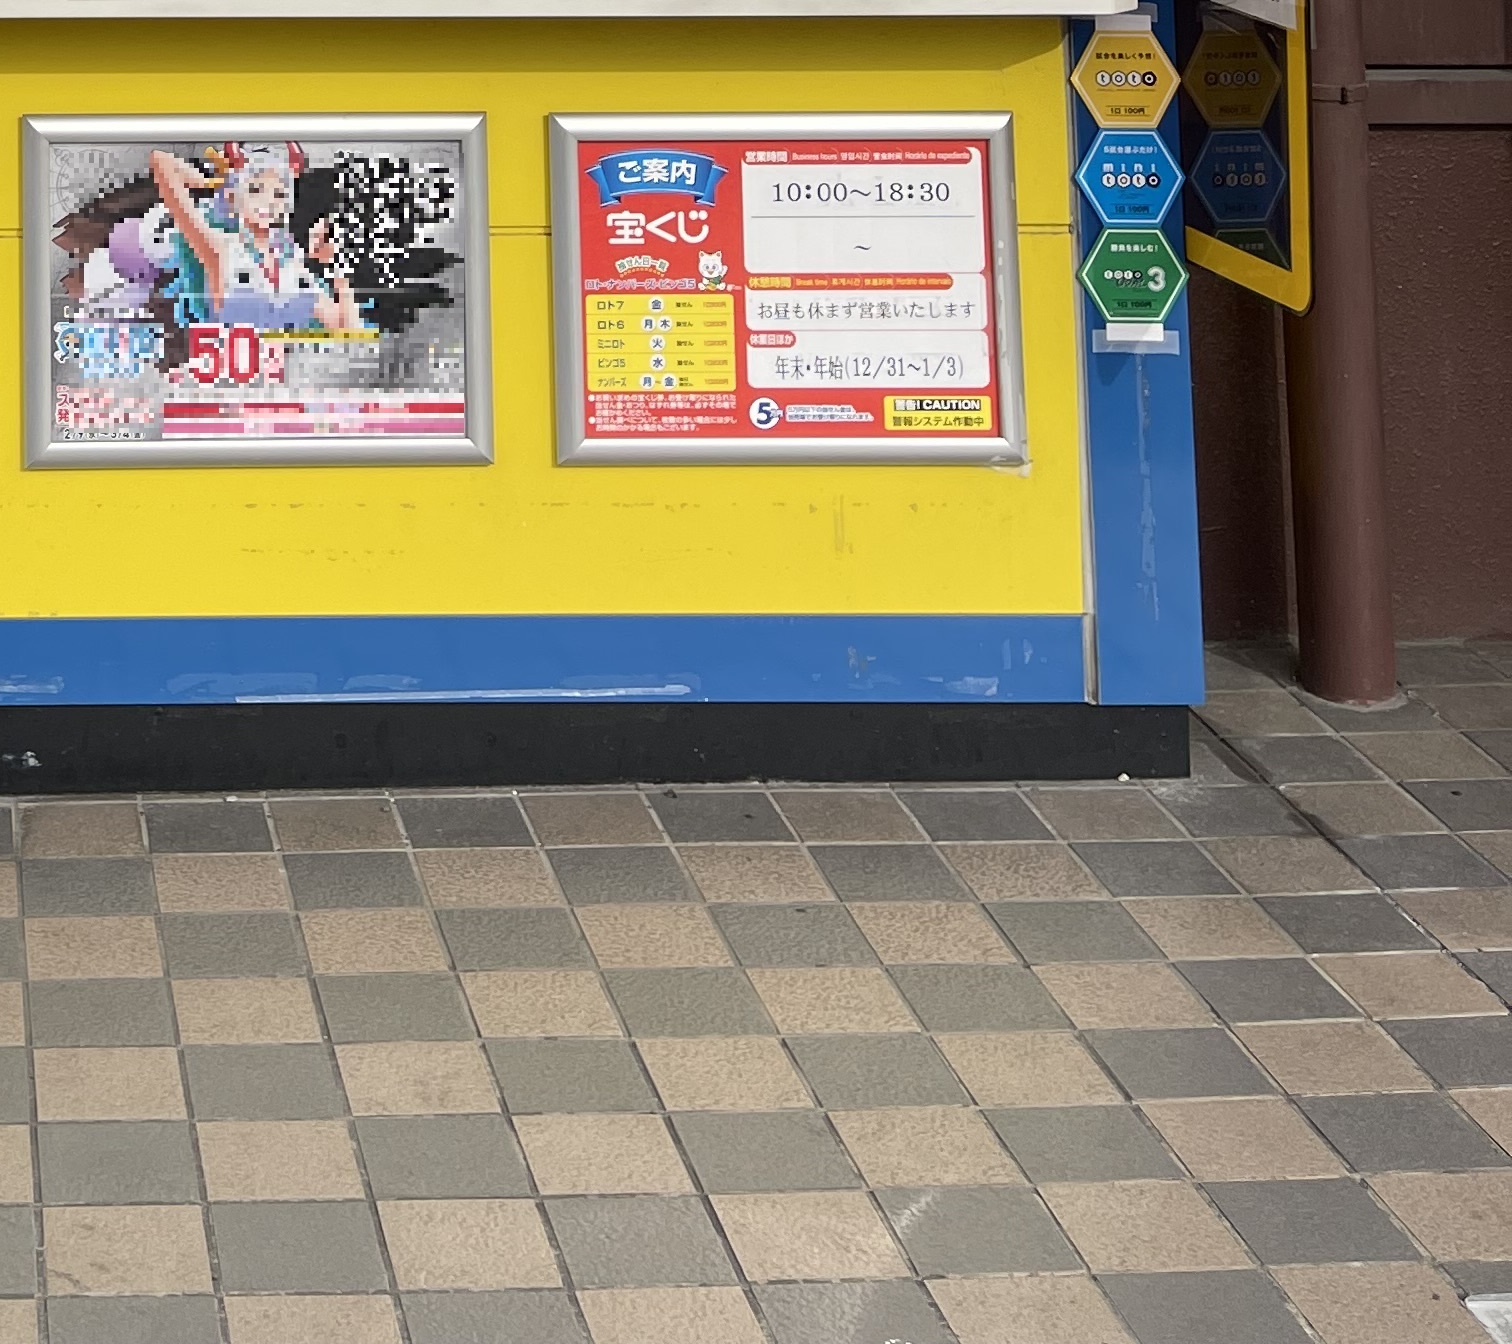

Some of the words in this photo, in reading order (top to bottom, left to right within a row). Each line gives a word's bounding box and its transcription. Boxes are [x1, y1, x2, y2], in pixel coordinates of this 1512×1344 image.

[1096, 71, 1157, 86] toto
[745, 151, 788, 162] 営業時間
[617, 158, 697, 186] ご案内
[1102, 173, 1160, 188] toto
[606, 210, 709, 245] 宝くじ
[597, 301, 624, 310] ロト7
[651, 299, 662, 309] 金
[758, 302, 975, 319] お昼も休まず営業いたします
[597, 320, 625, 329] ロト6
[643, 319, 653, 329] 月
[660, 319, 670, 329] 木
[597, 339, 625, 349] ミニロト
[652, 338, 663, 348] 火
[598, 358, 626, 368] ビンゴ5
[652, 358, 664, 368] 水
[597, 377, 627, 387] ナンバーズ
[922, 399, 980, 410] CAUTION
[892, 416, 984, 426] 警報システム作動中
